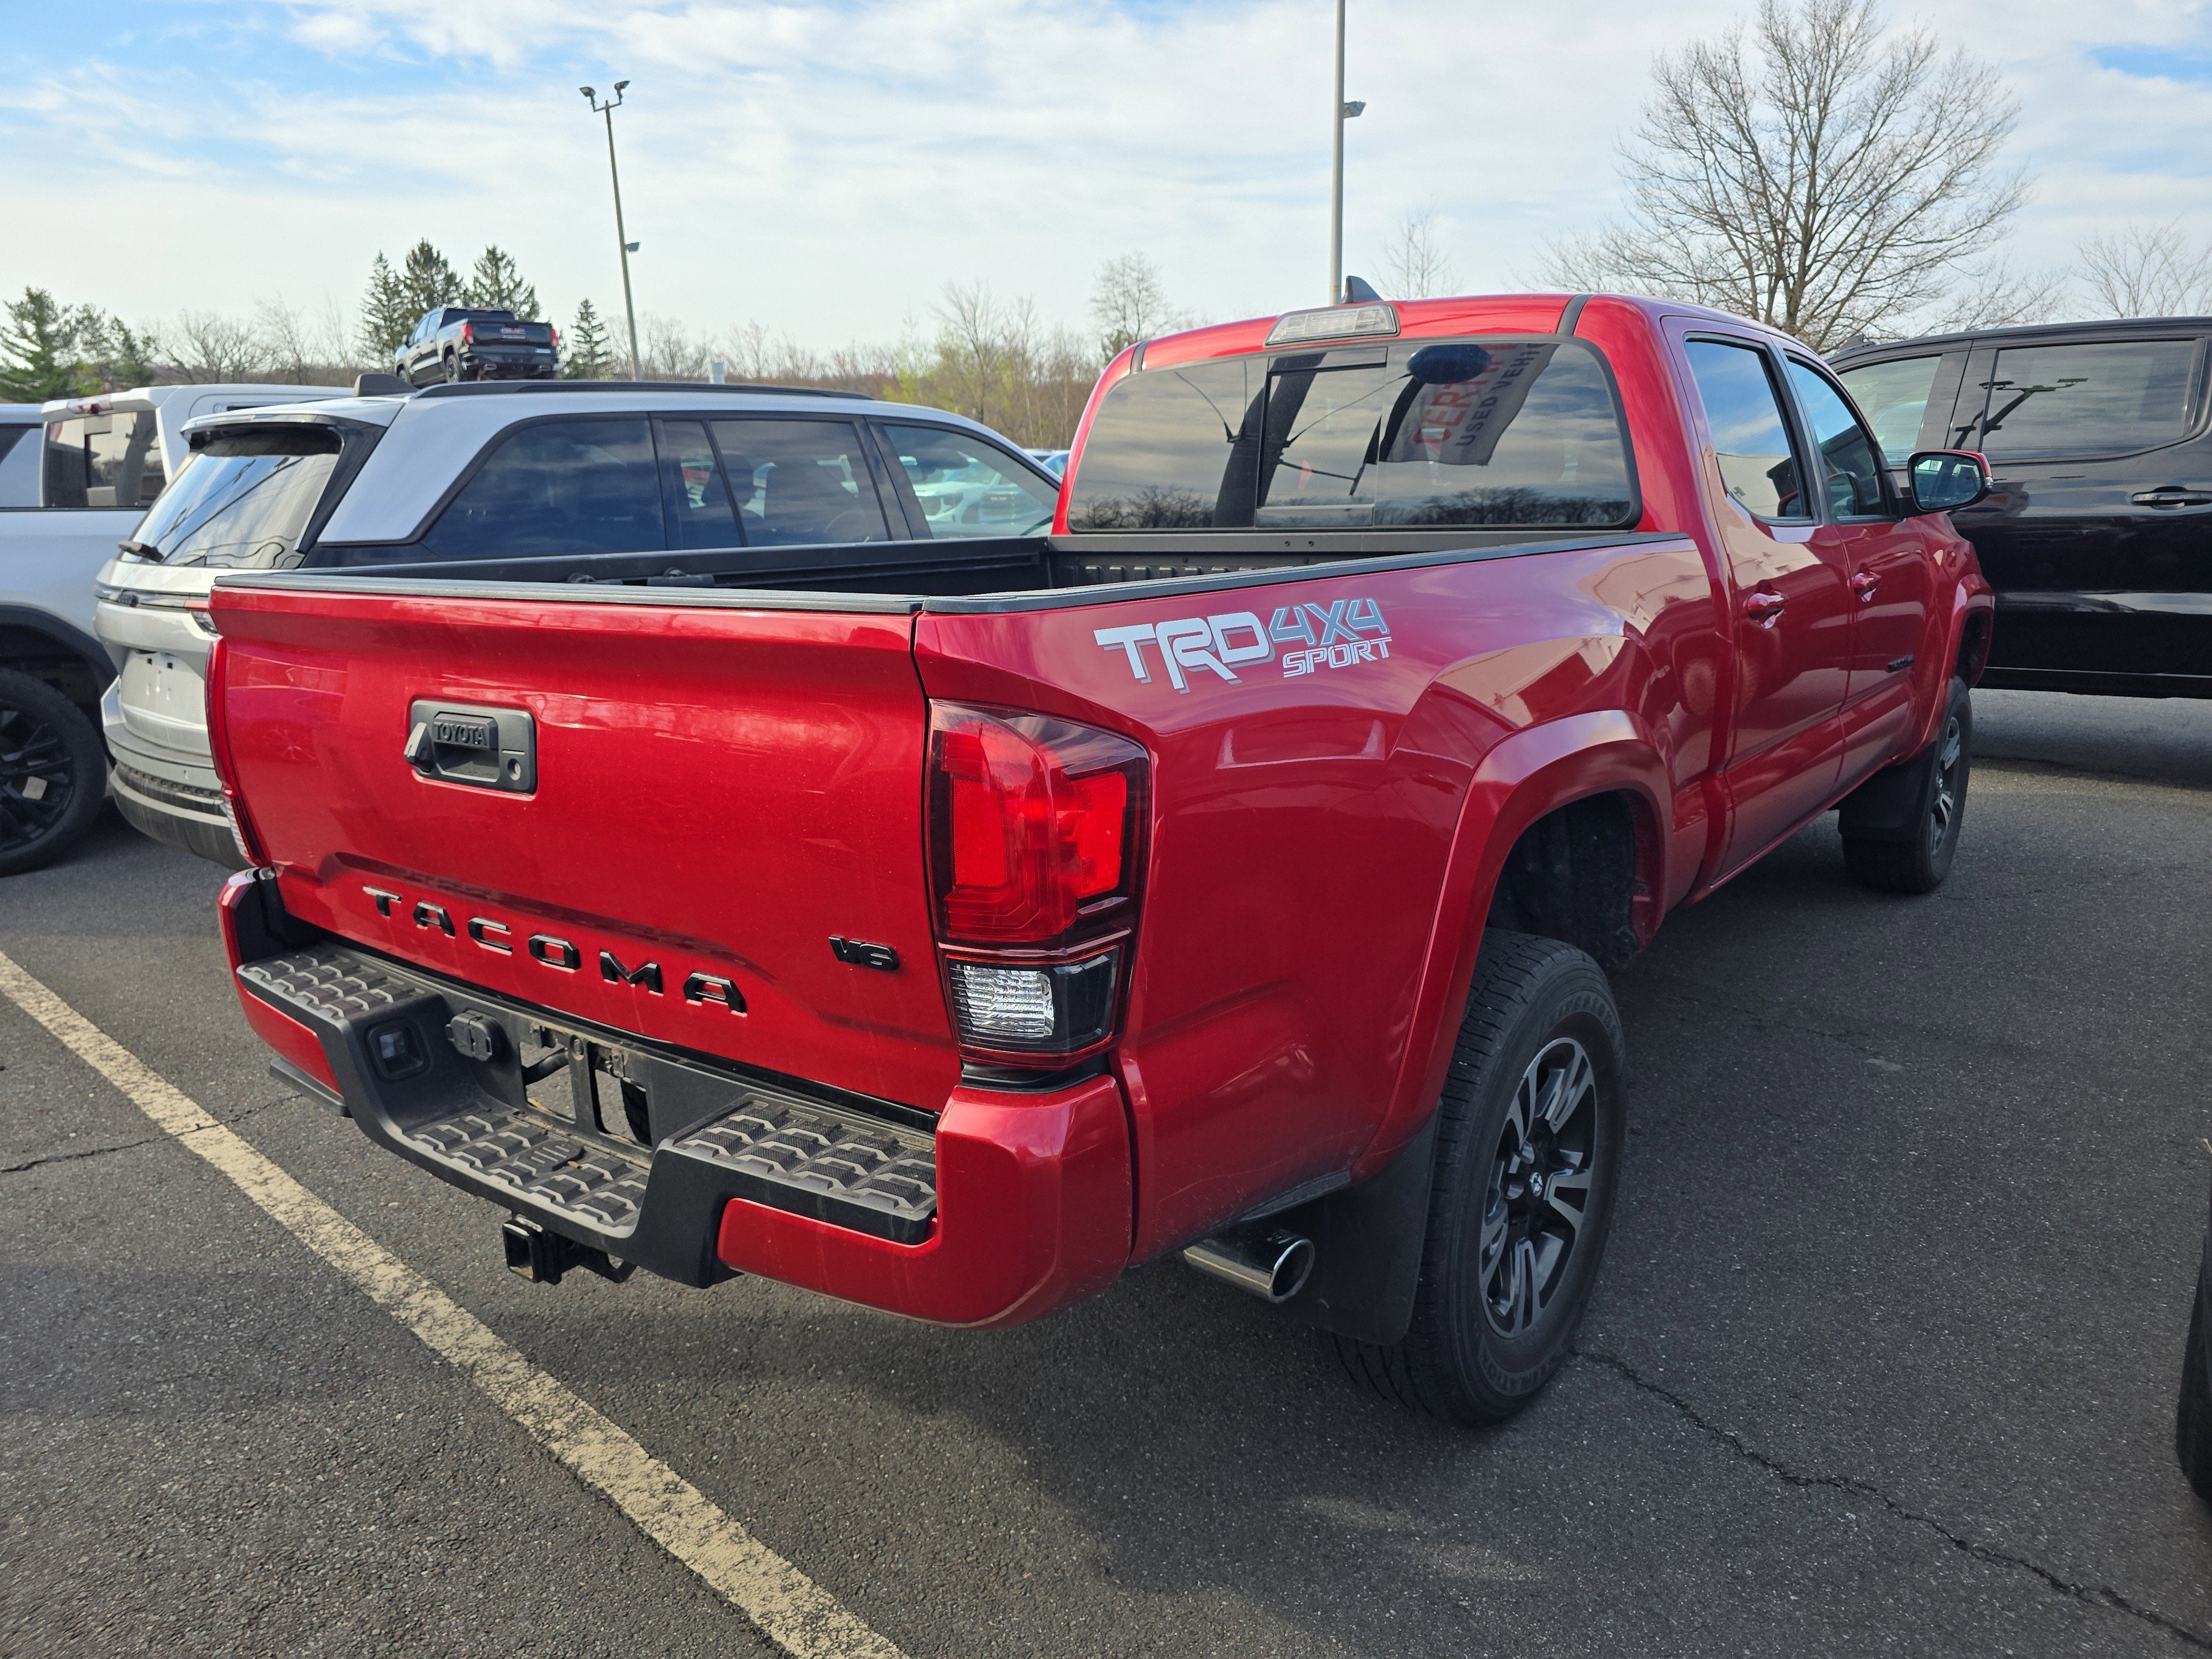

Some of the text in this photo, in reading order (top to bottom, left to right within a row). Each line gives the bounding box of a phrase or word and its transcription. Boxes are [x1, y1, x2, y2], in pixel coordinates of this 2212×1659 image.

[1455, 396, 1498, 446] USED
[1093, 612, 1275, 694] TRD
[1282, 636, 1392, 678] SPORT
[434, 721, 487, 746] TOYOTA
[362, 885, 747, 1017] TACOMA
[827, 935, 900, 972] V6
